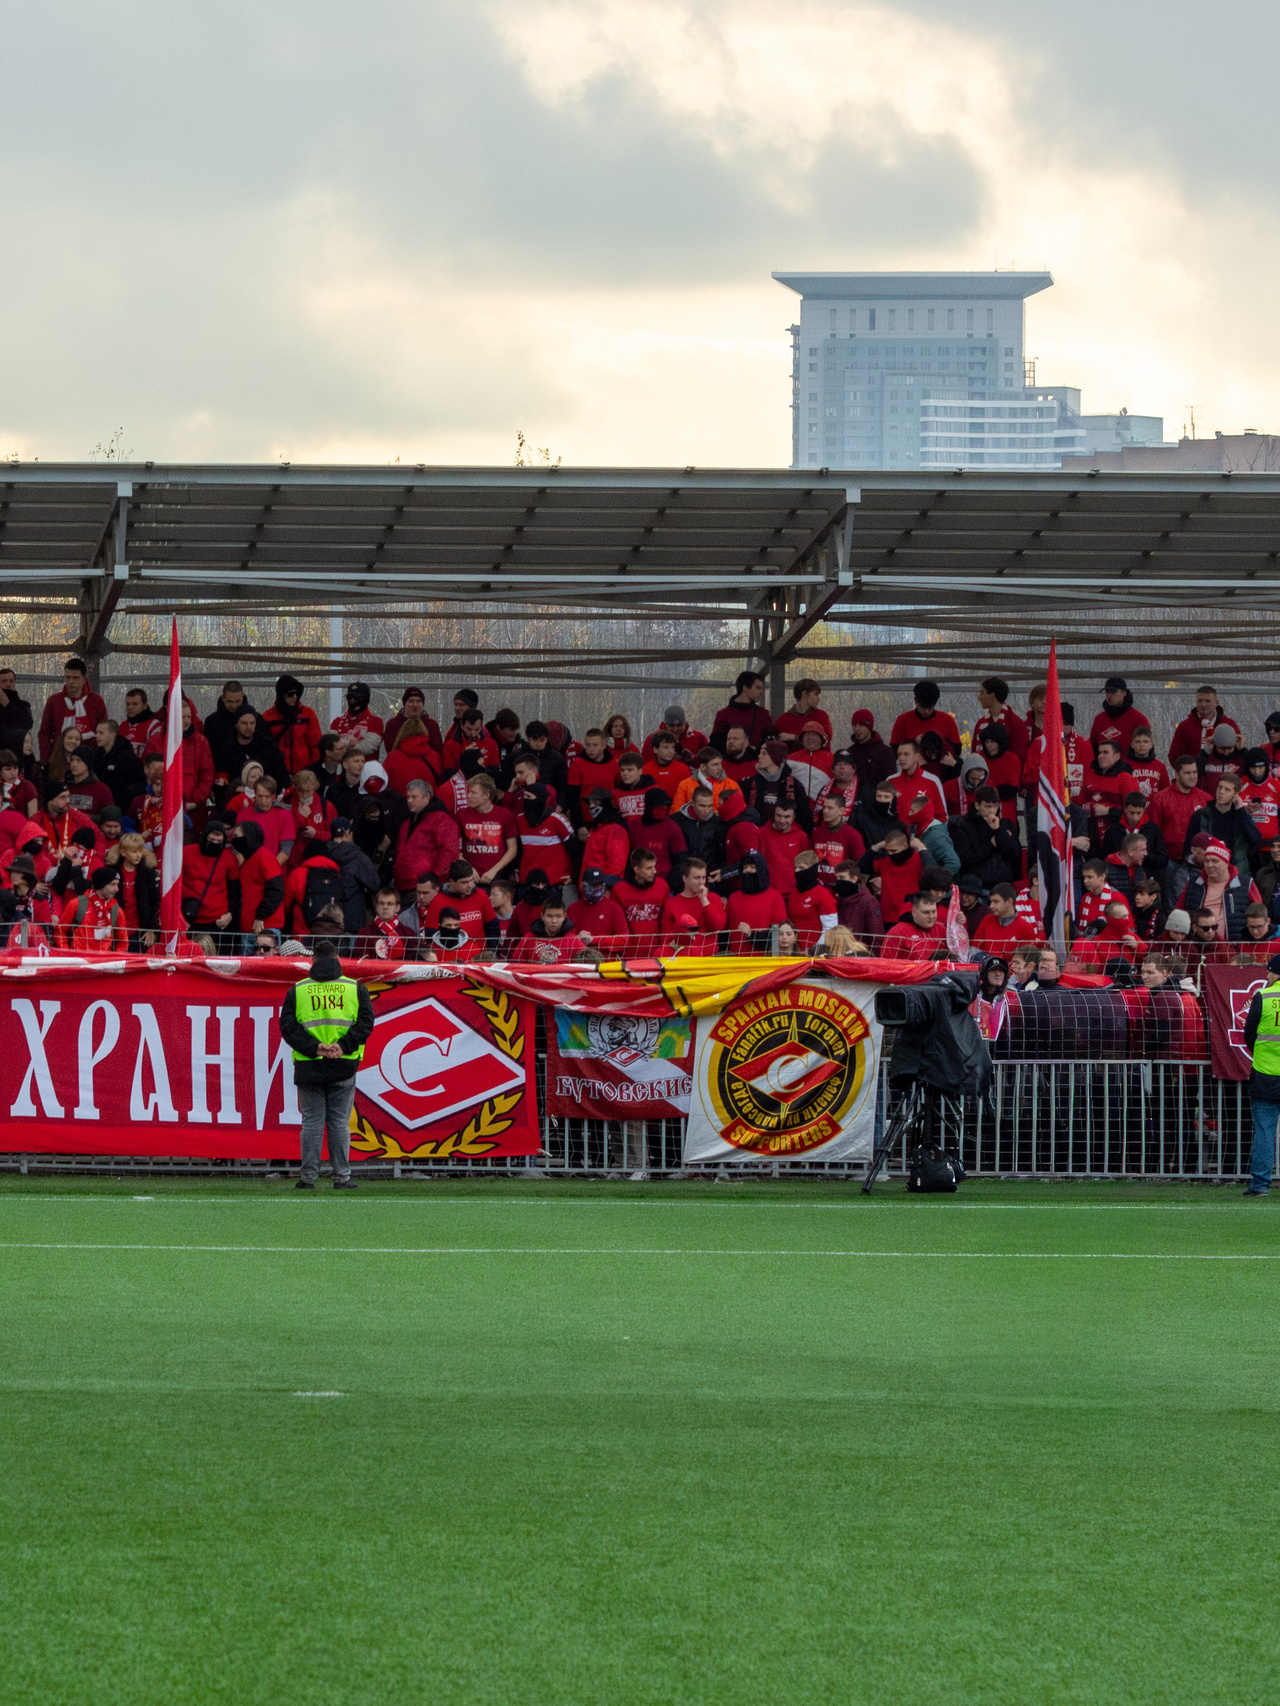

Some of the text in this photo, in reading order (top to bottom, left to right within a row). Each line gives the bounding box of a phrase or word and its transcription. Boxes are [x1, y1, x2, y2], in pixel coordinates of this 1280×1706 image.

[466, 845, 499, 854] ULTRAS
[308, 985, 345, 994] STEWARD
[311, 995, 344, 1011] D184
[717, 989, 792, 1041] SPARTAK
[798, 989, 866, 1040] MOSCOW
[805, 1014, 845, 1056] forever
[556, 1075, 693, 1103] БУТОВСКИЕ
[731, 1081, 778, 1128] навсегда
[729, 1120, 833, 1152] SUPPORTERS
